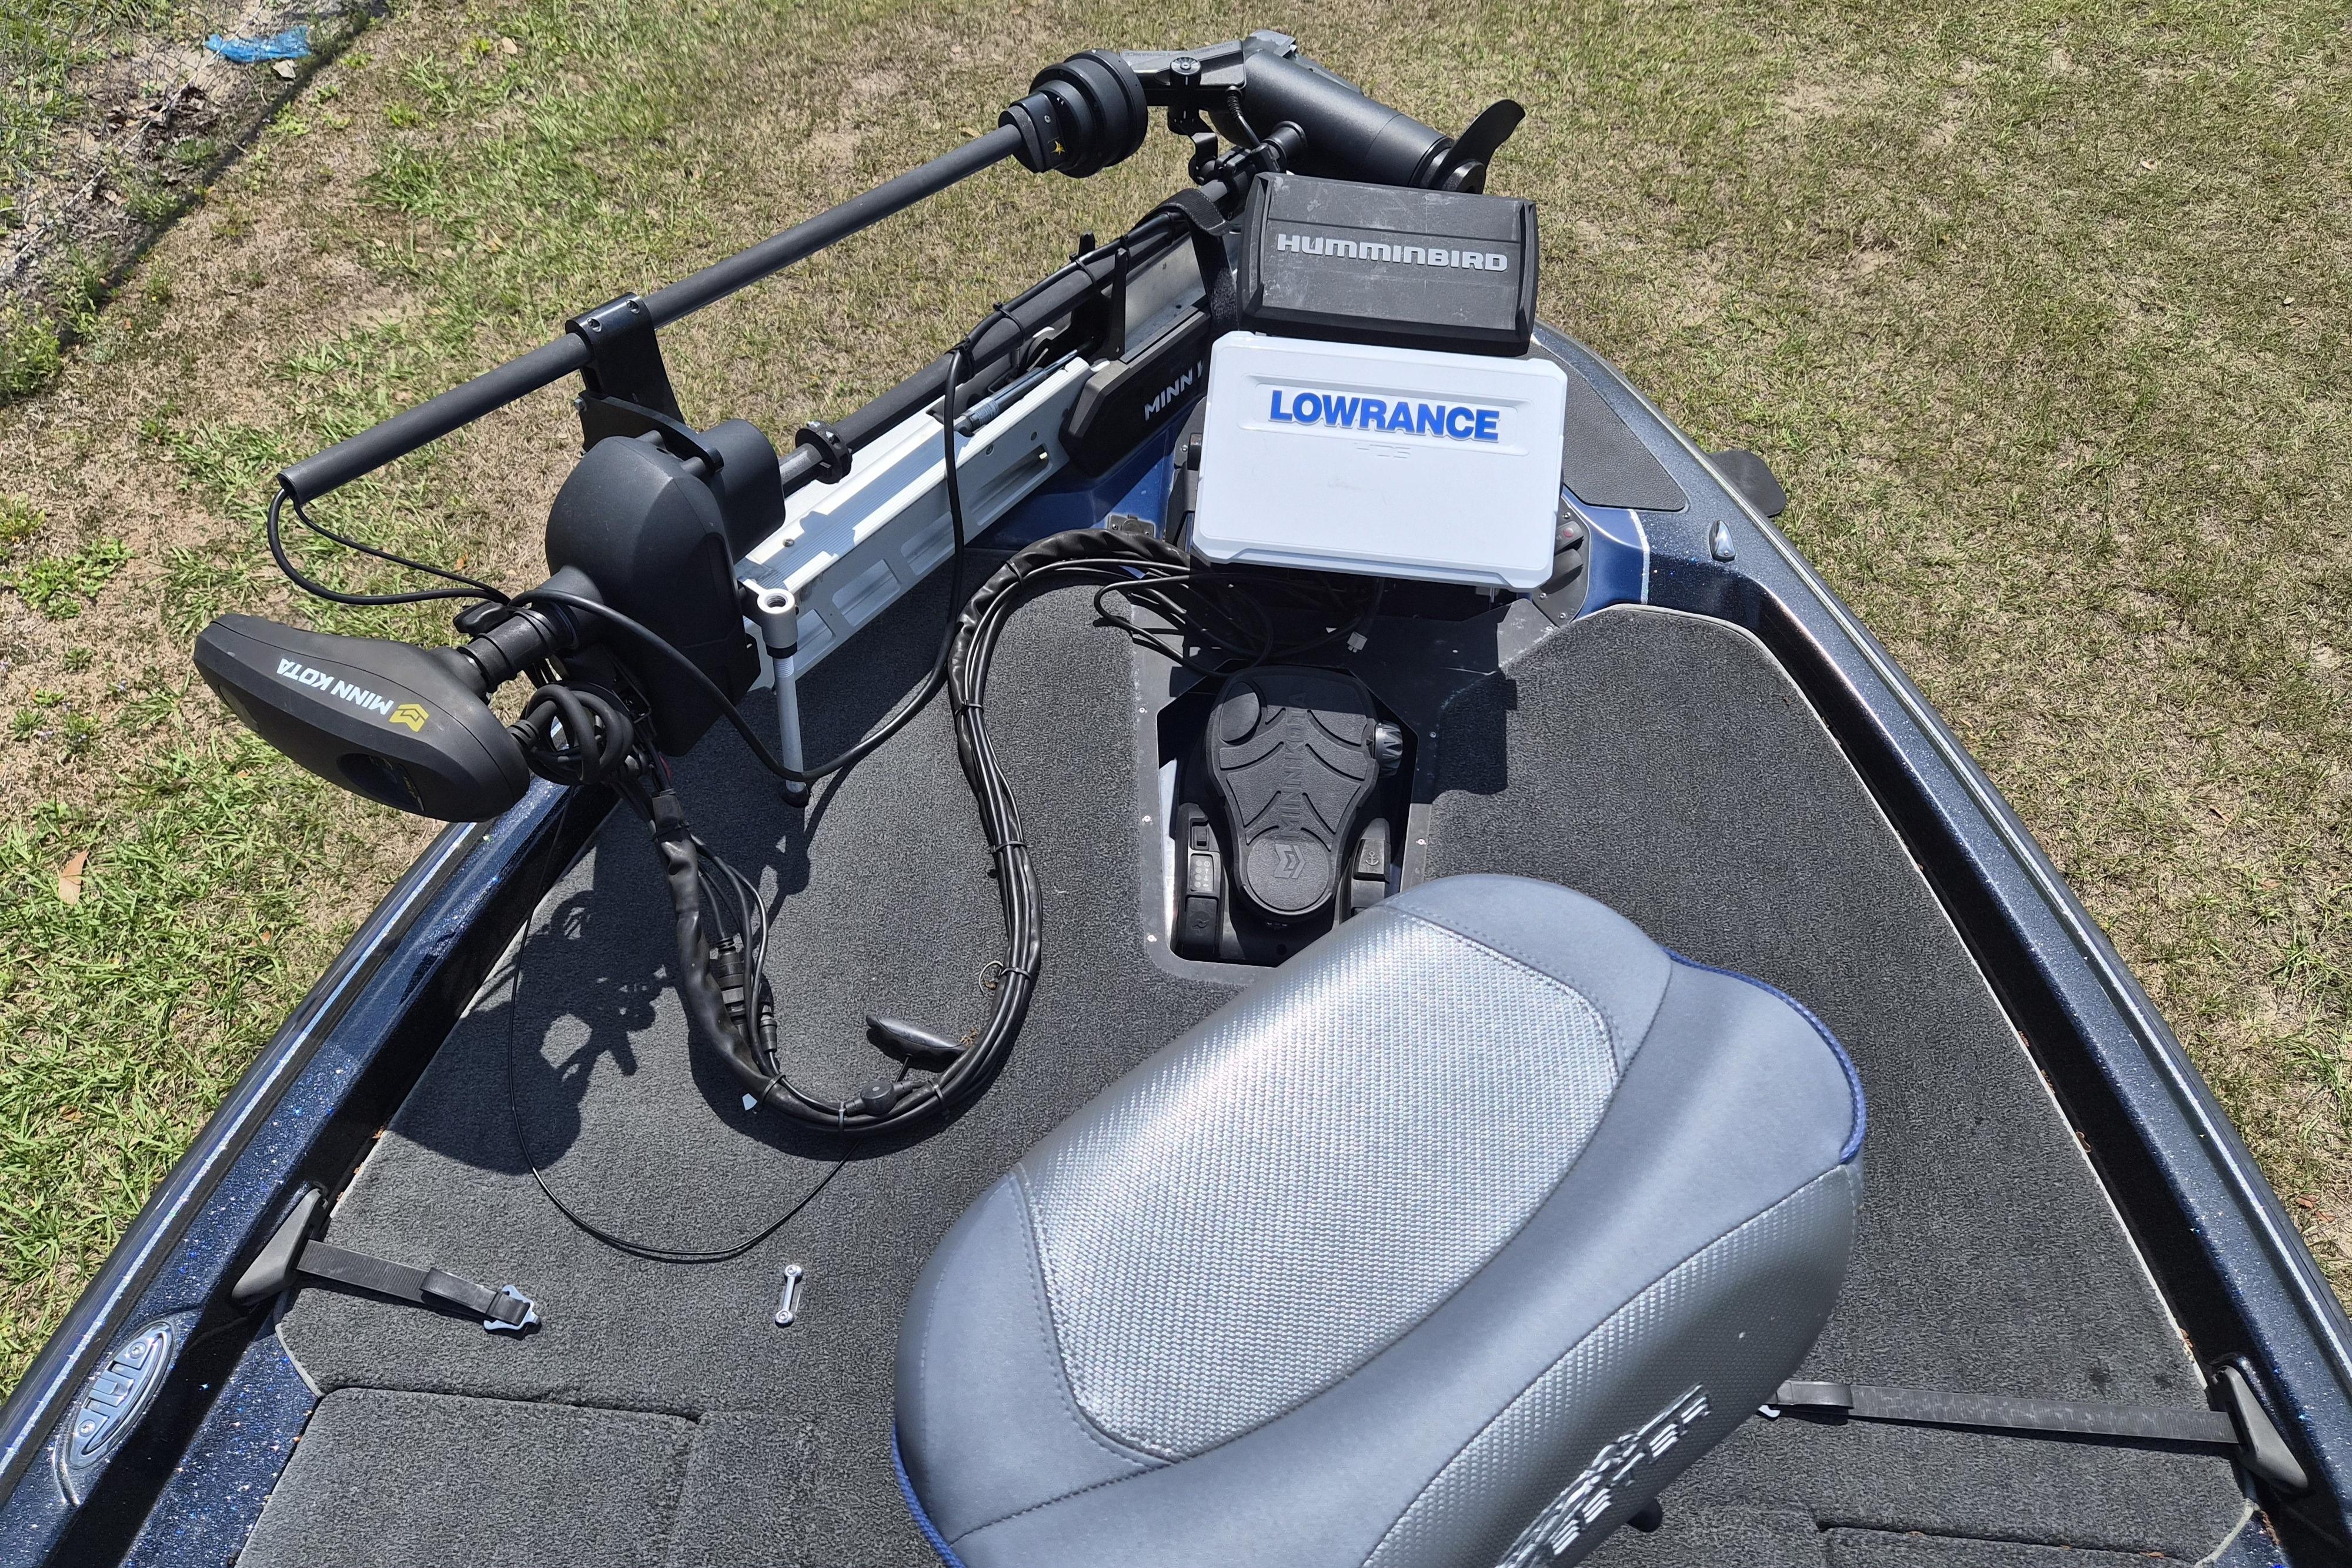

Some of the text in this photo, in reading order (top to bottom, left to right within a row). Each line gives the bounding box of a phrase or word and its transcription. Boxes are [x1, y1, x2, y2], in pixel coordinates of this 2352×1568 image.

[1277, 233, 1508, 272] HUMMINBIRD
[1144, 367, 1192, 421] MINN
[1270, 390, 1500, 442] LOWRANCE
[276, 658, 395, 715] MINN KOTA
[1279, 693, 1307, 840] MINN KOTA
